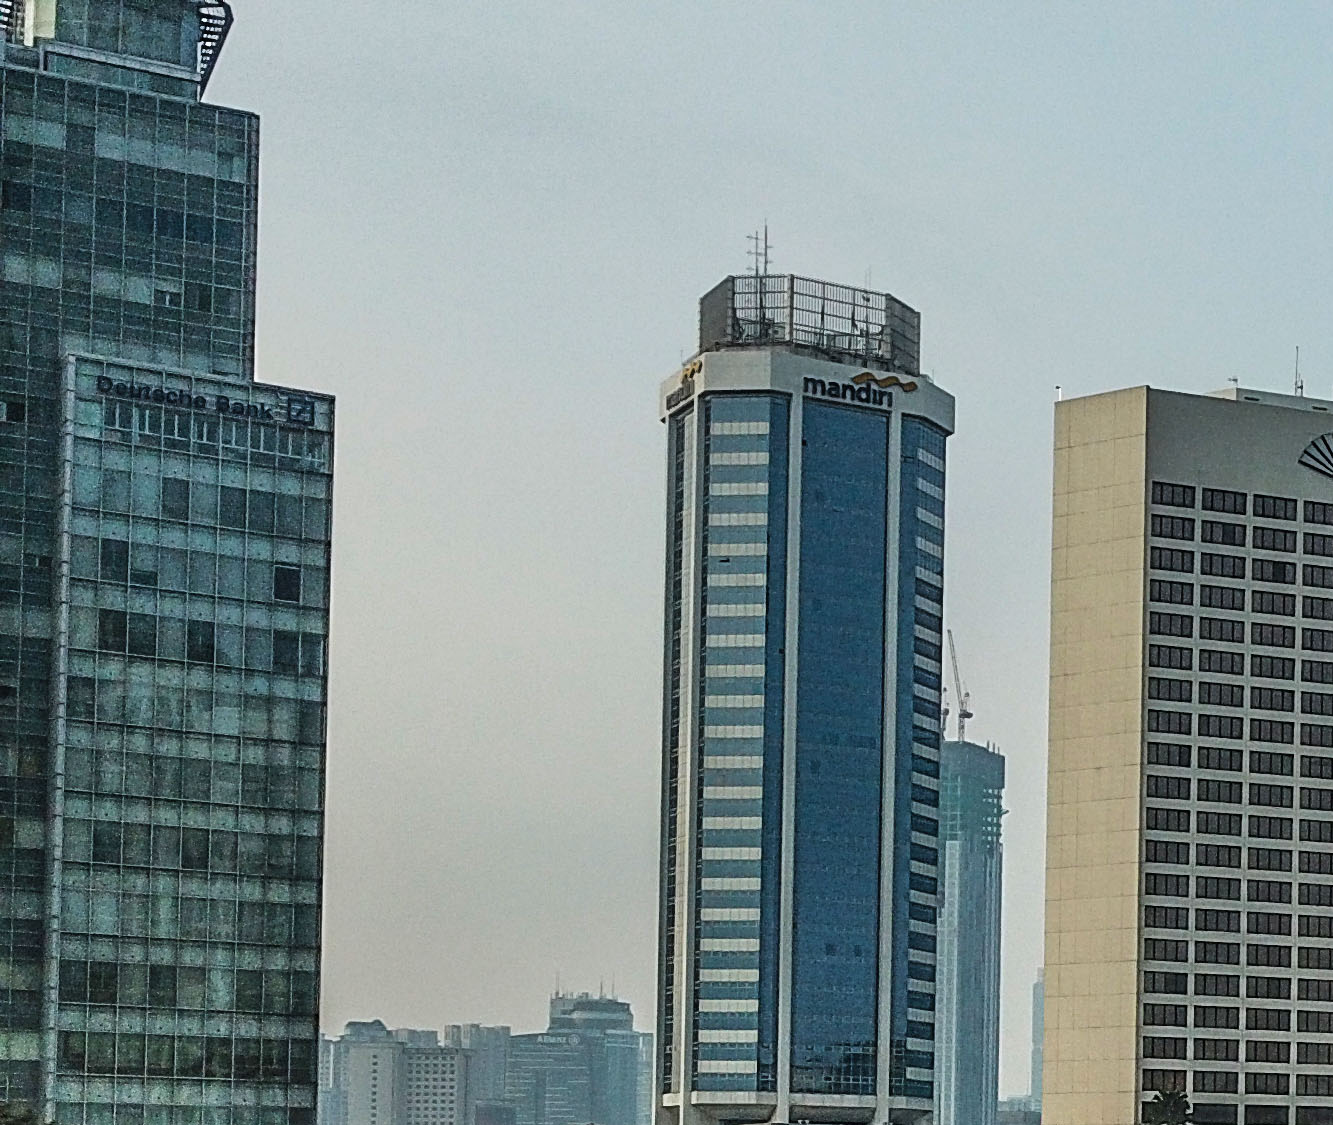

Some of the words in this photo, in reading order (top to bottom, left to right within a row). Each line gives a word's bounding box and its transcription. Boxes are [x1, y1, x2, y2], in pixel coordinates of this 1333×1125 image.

[98, 376, 207, 408] Deutsche
[216, 395, 273, 420] Bank
[802, 375, 893, 408] mandiri
